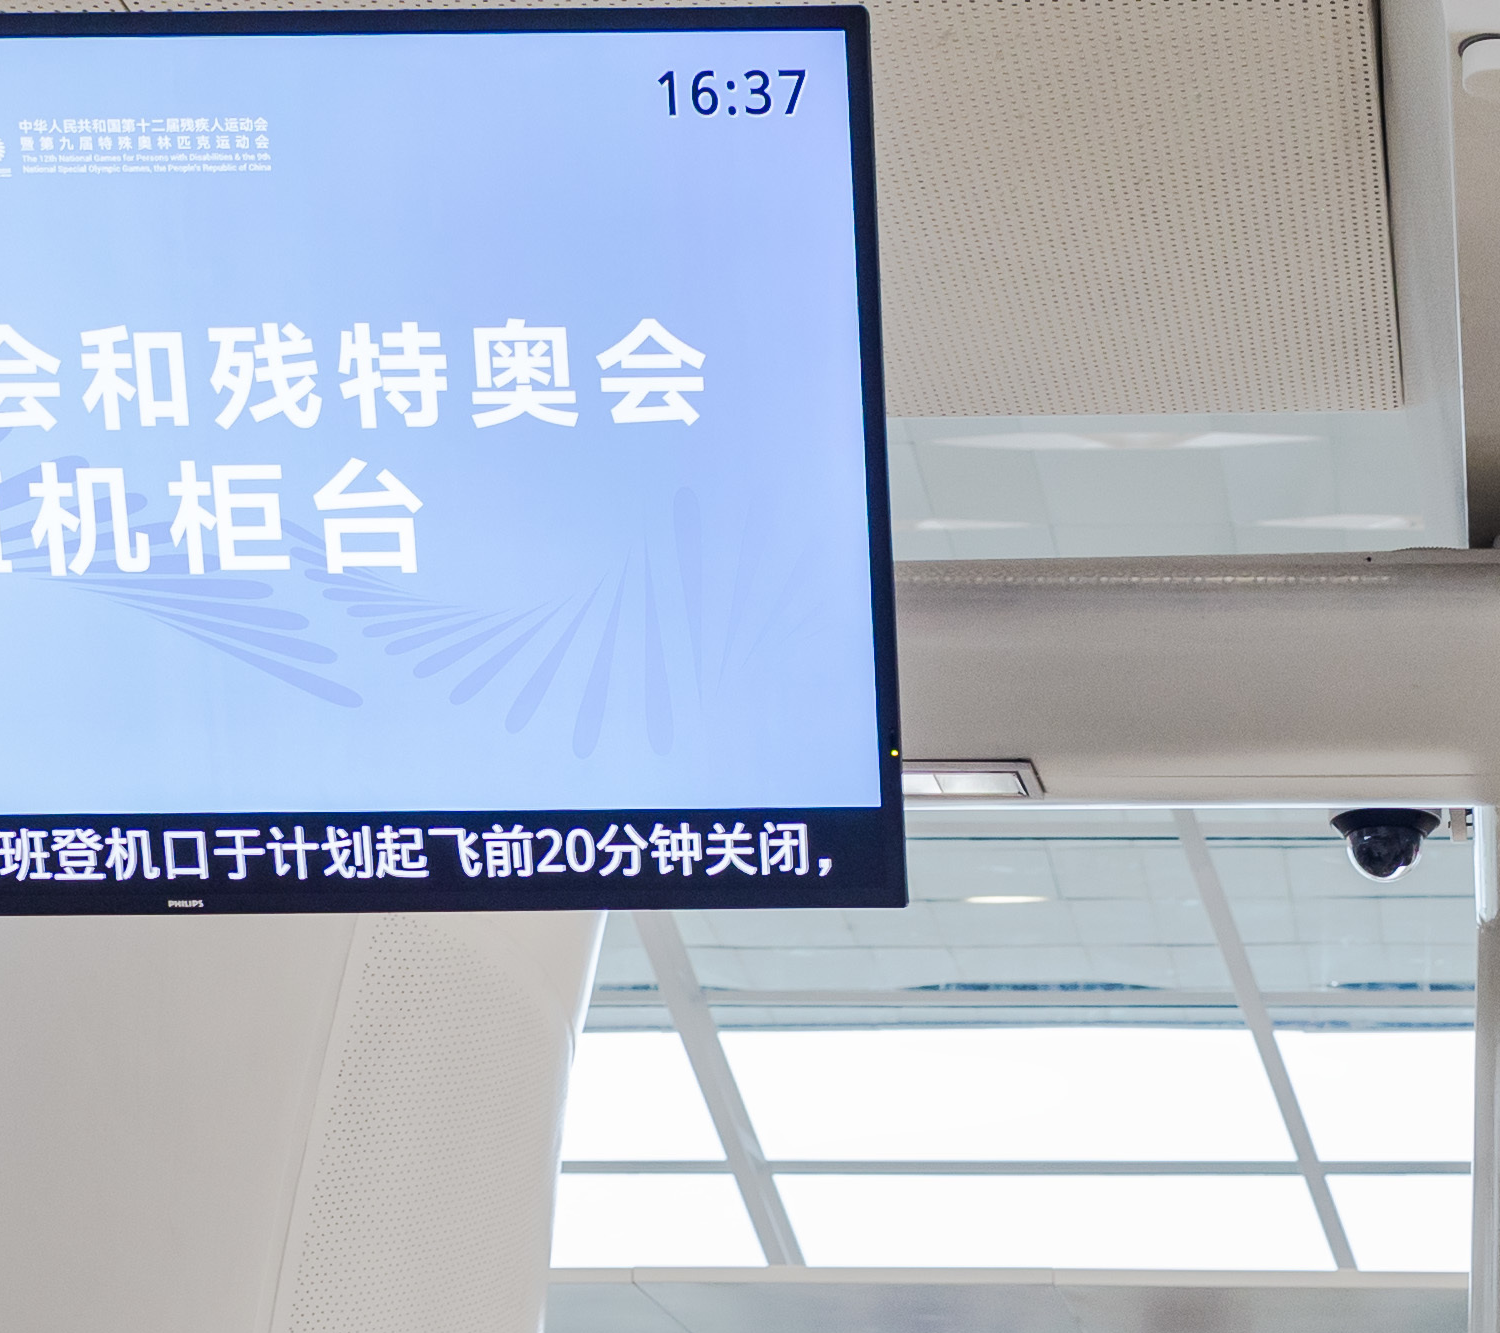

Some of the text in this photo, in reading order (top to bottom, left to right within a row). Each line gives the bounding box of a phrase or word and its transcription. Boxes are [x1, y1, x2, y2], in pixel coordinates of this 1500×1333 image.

[658, 70, 805, 115] 16:37
[19, 117, 268, 134] 中华人民共和国第十二届残疾人运动会
[167, 899, 205, 908] PHILIPS
